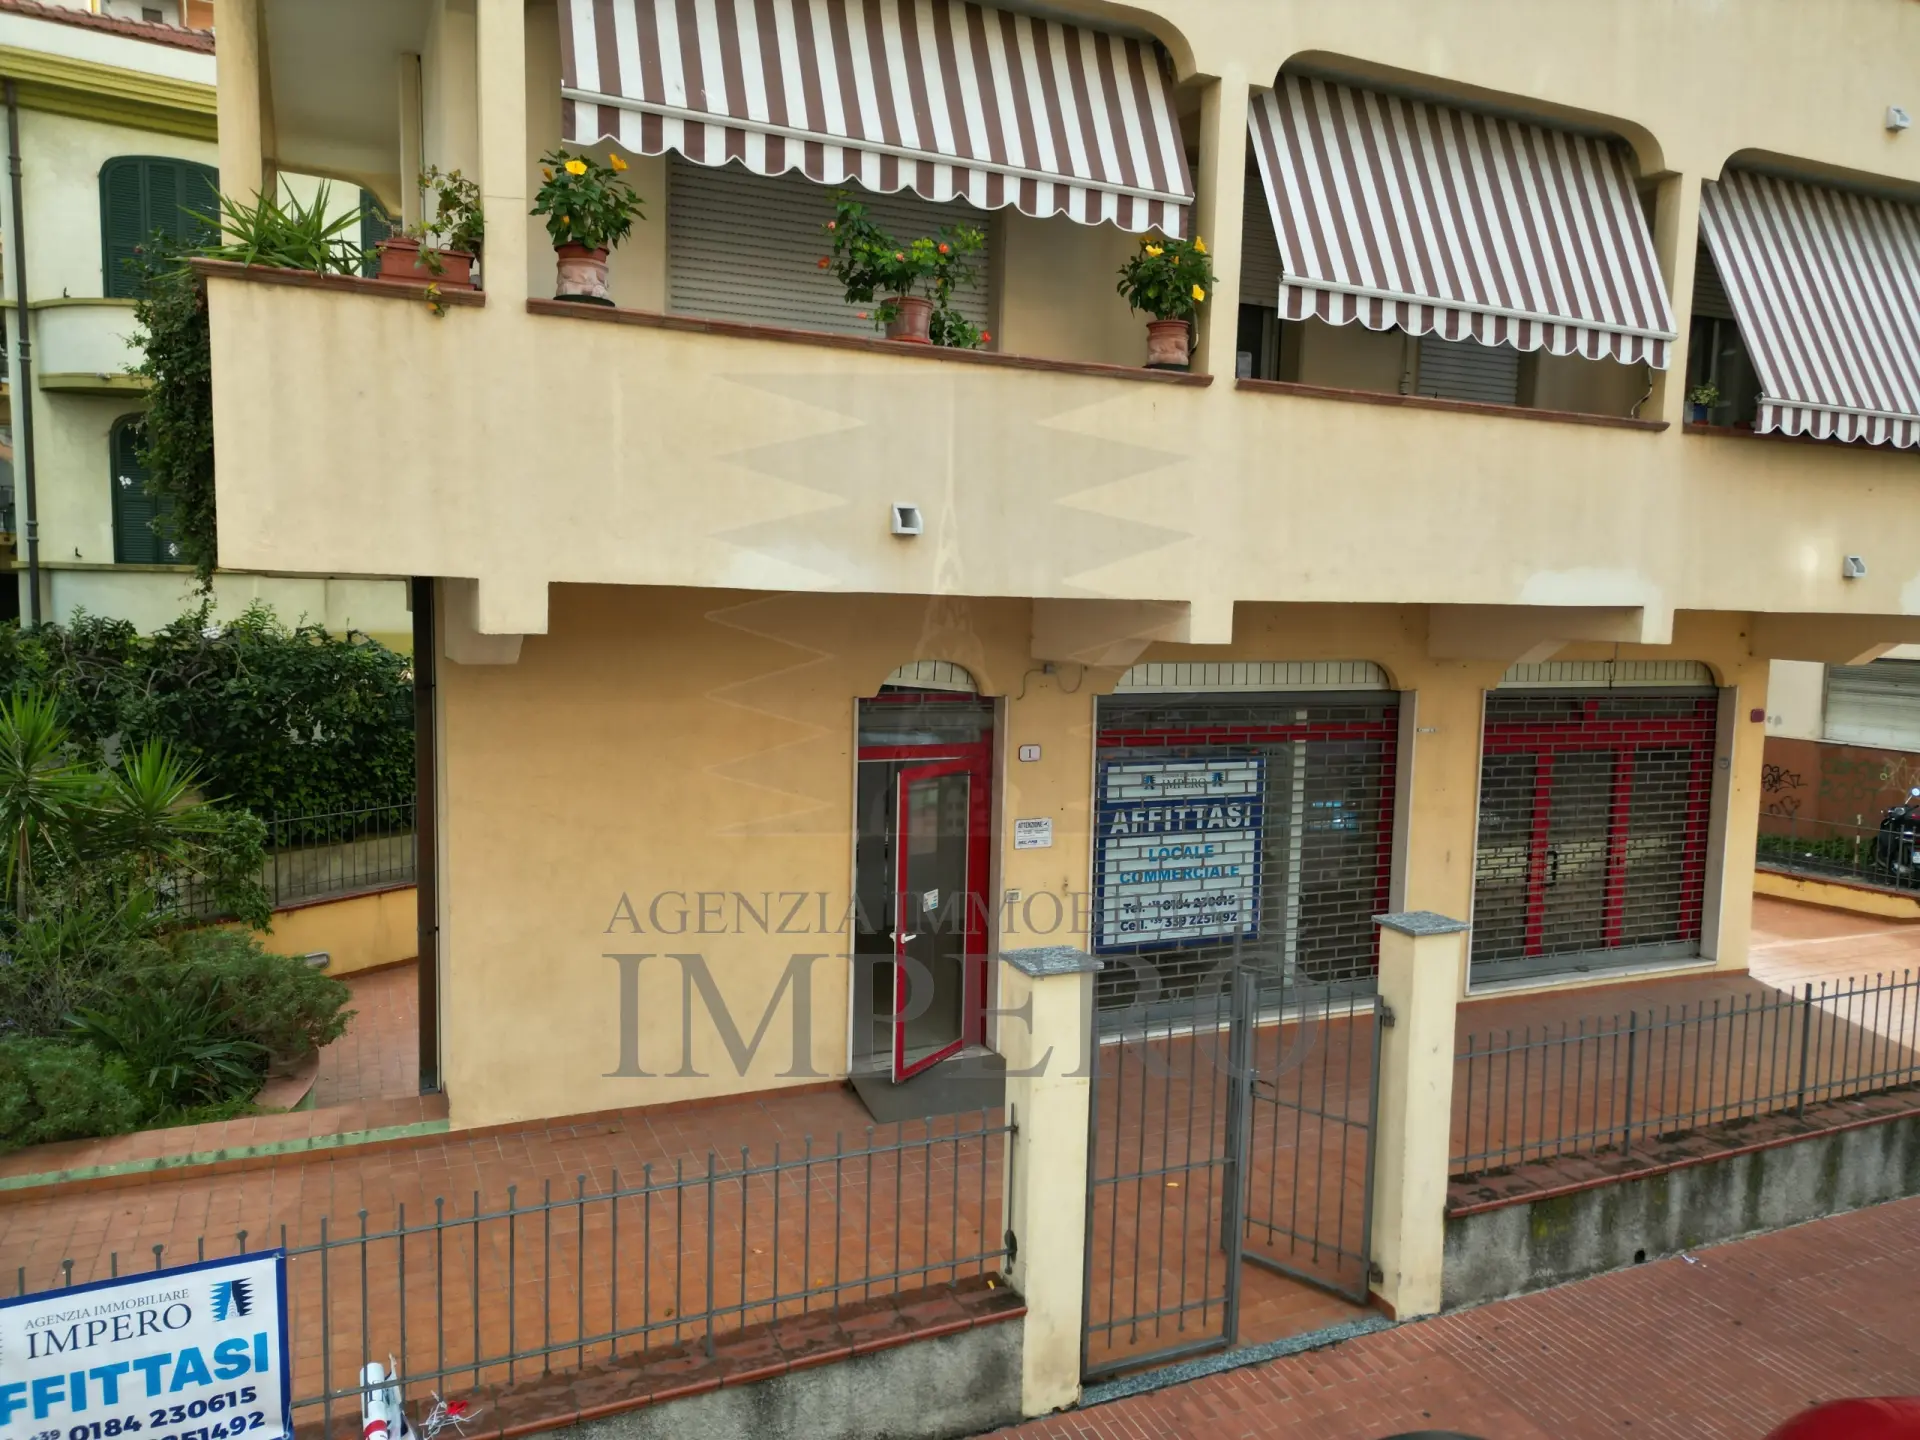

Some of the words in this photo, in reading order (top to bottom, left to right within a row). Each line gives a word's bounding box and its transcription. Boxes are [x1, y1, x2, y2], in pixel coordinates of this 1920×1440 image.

[1161, 777, 1207, 790] IMPERO
[1110, 801, 1251, 834] AFFITTASI
[1148, 844, 1215, 862] LOCALE
[1119, 865, 1240, 884] COMMERCIALE
[1120, 919, 1148, 931] Cel.
[24, 1309, 91, 1331] AGENZIA
[94, 1288, 189, 1317] IMMOBILIARE
[27, 1303, 193, 1360] IMPERO
[69, 1414, 143, 1440] 0184
[149, 1386, 258, 1429] 230615
